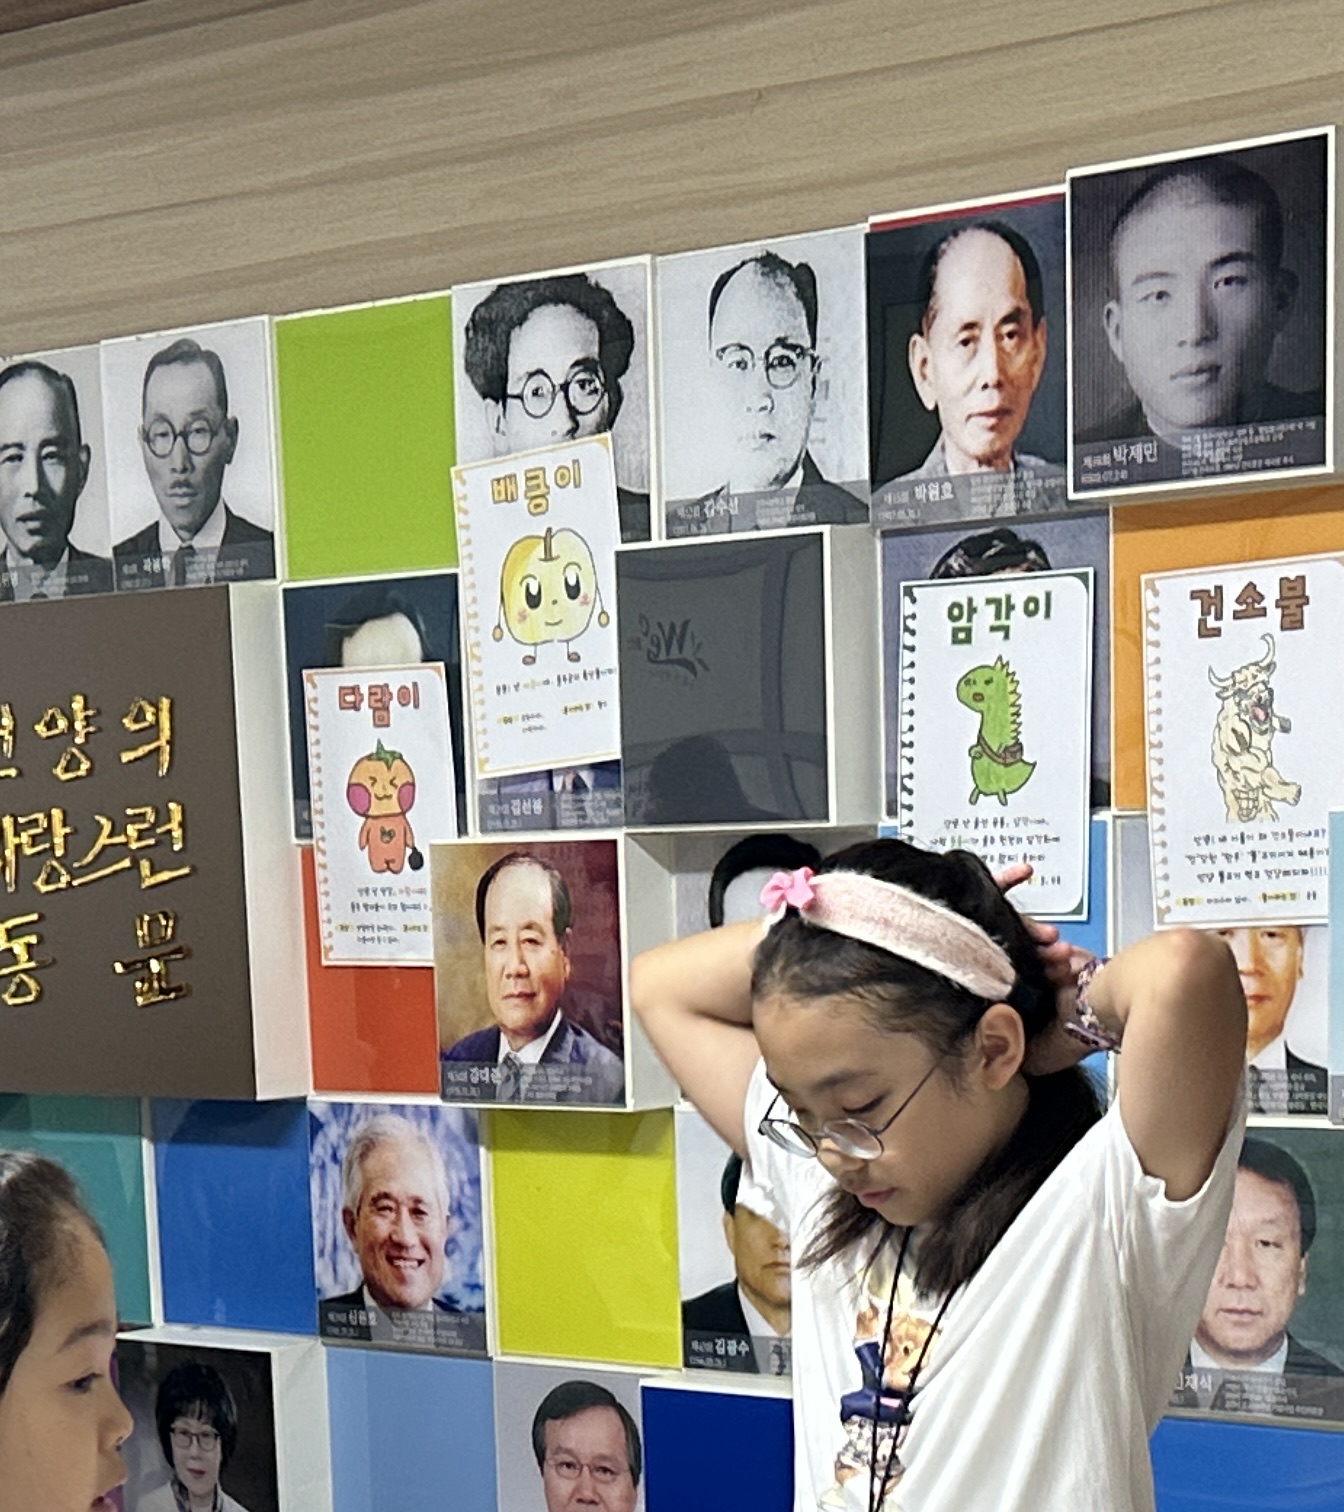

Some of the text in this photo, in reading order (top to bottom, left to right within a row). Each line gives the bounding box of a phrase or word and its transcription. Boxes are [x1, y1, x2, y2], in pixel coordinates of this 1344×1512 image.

[947, 590, 1053, 646] 암각이
[1189, 575, 1310, 639] 건소불
[338, 681, 420, 728] 다람이
